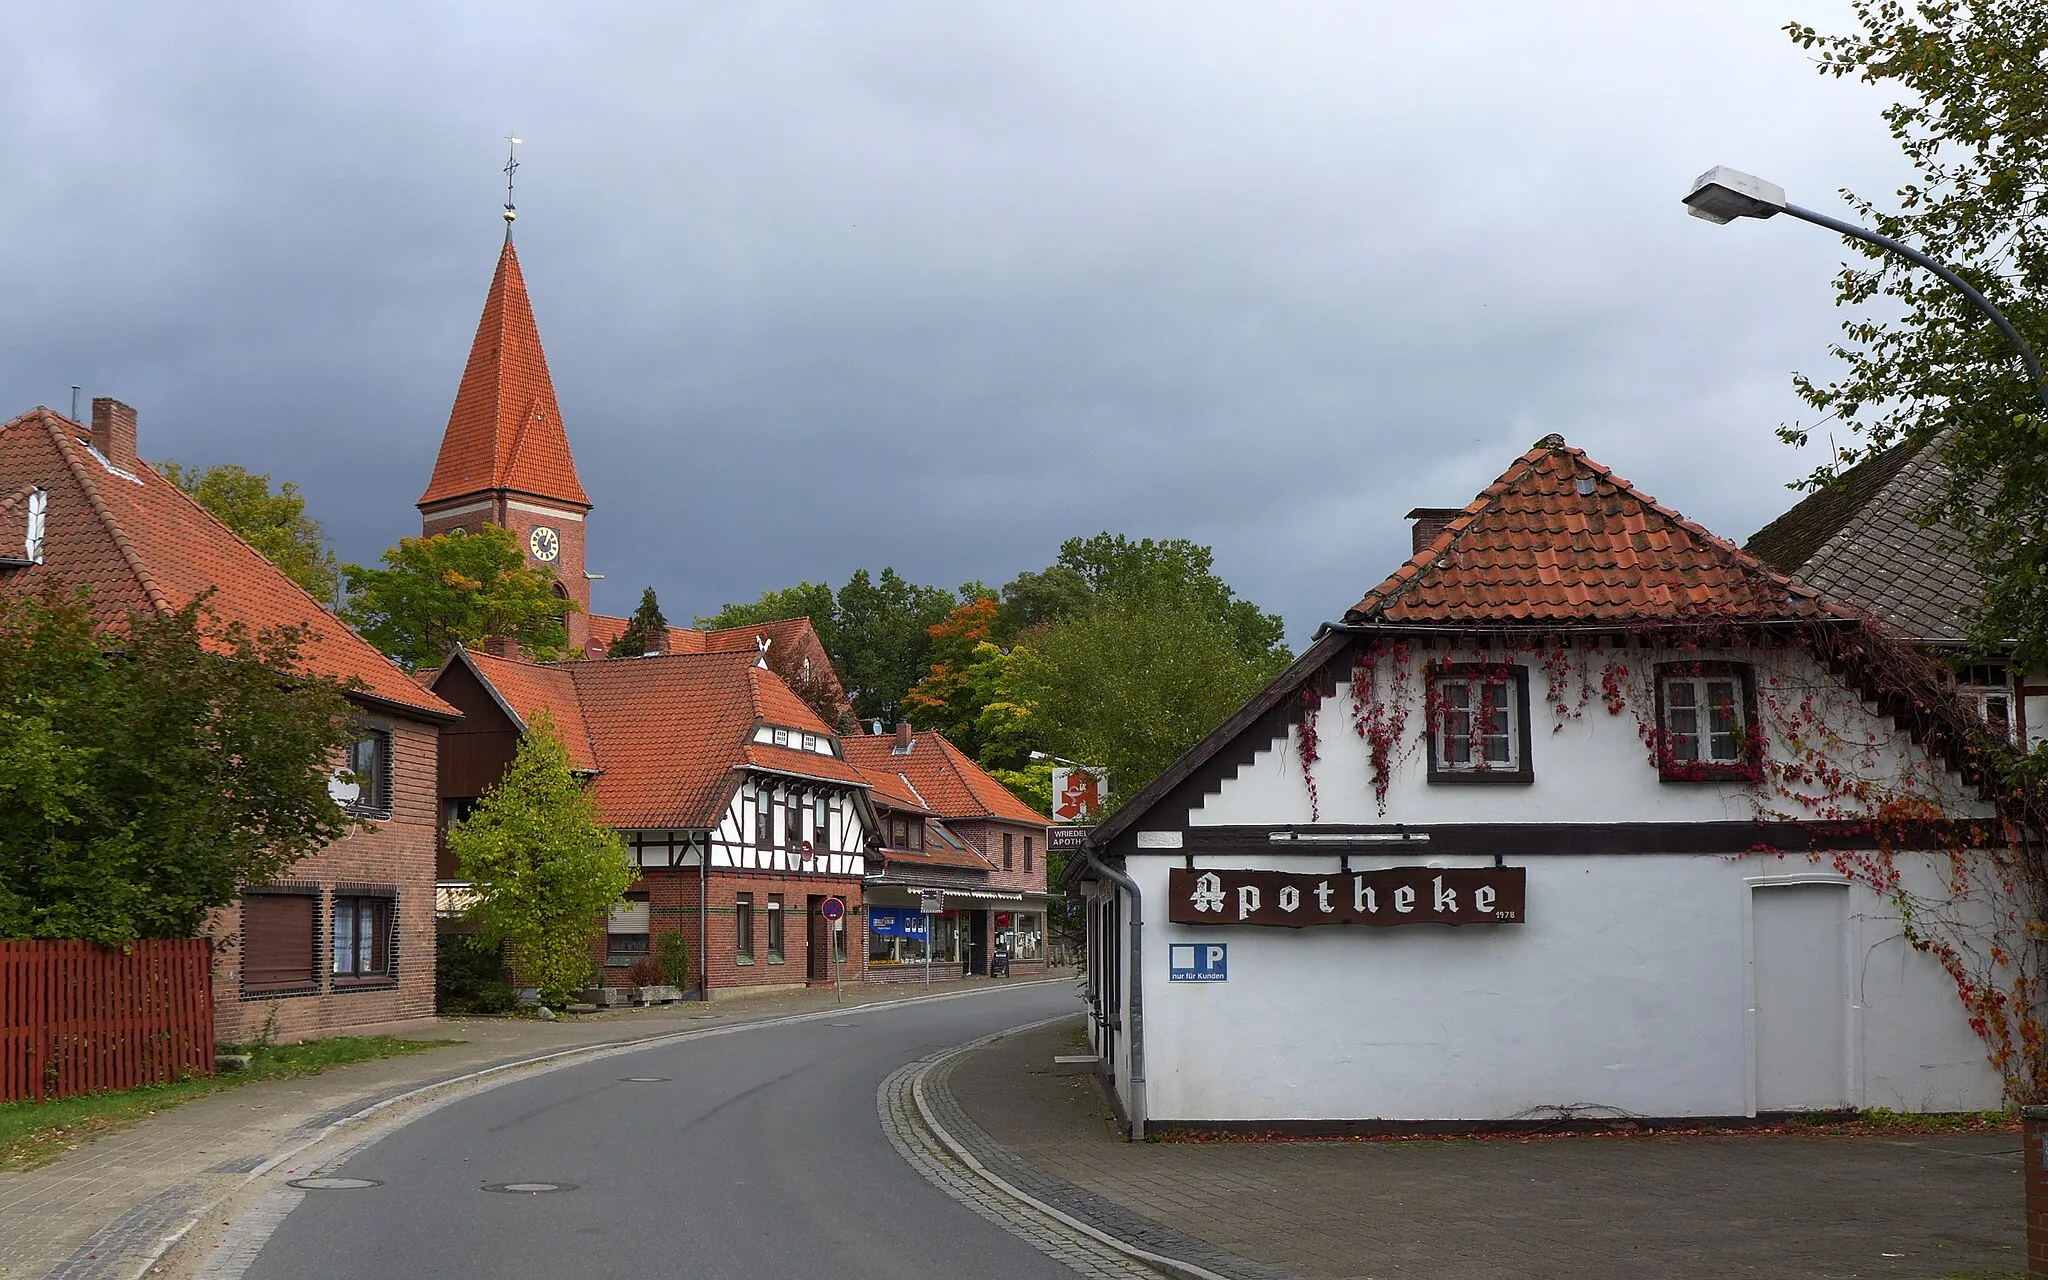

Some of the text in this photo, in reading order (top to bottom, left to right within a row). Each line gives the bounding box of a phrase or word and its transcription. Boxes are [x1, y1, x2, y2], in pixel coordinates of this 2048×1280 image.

[1054, 830, 1087, 838] WRIEDEL
[1053, 838, 1081, 846] APOTH
[1189, 871, 1496, 921] Apotheke
[1495, 911, 1515, 919] 1978
[1206, 946, 1223, 969] P
